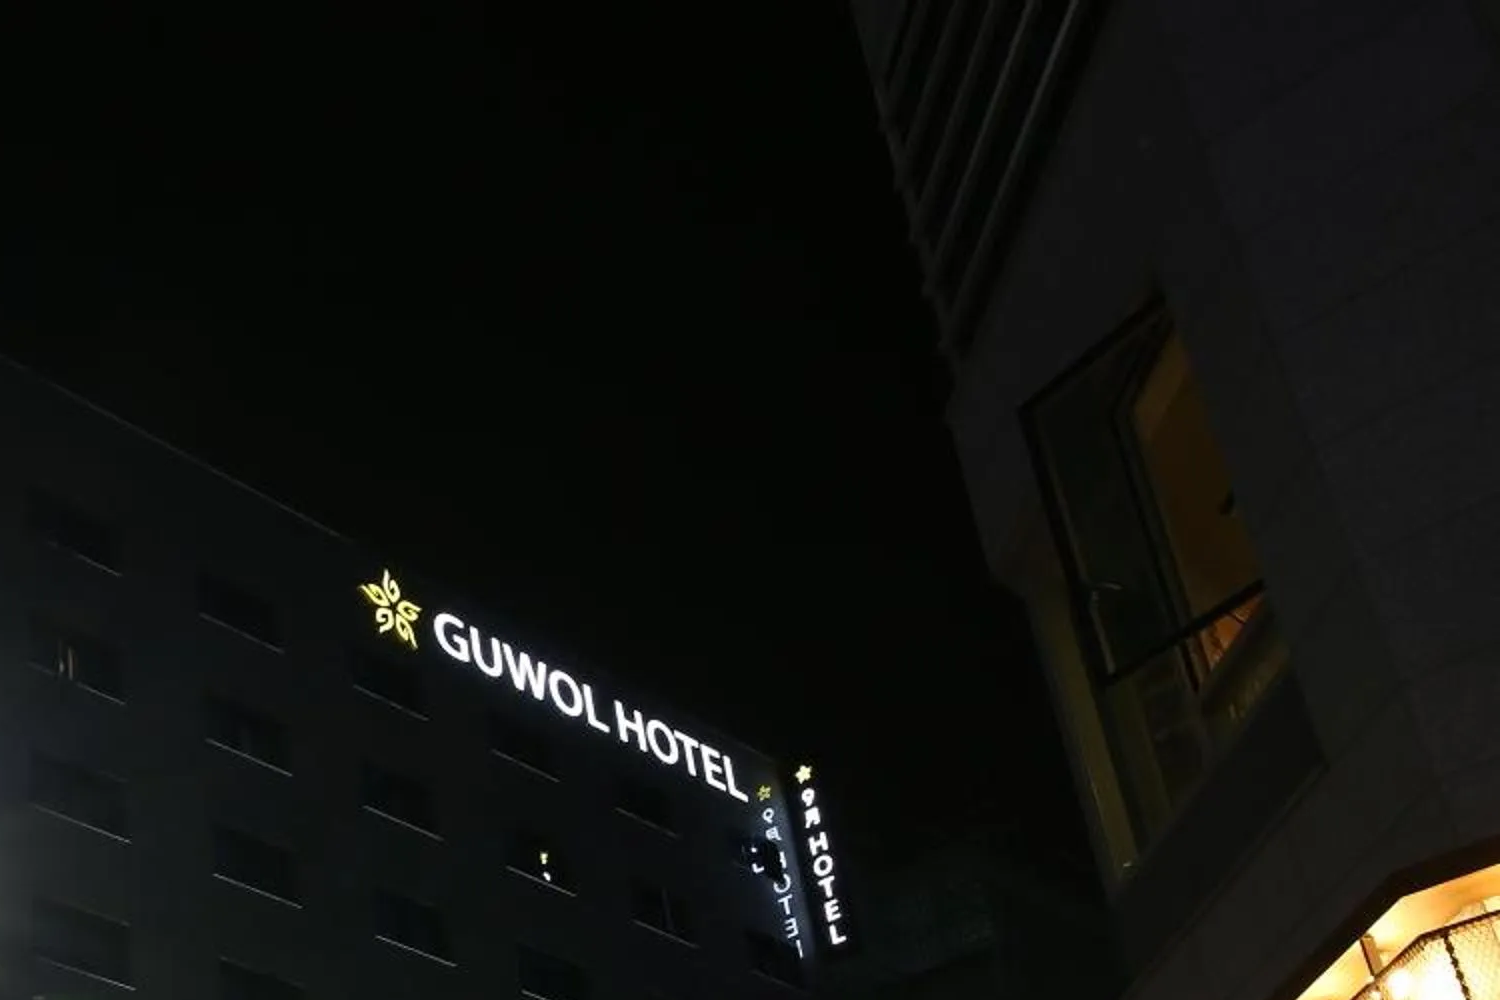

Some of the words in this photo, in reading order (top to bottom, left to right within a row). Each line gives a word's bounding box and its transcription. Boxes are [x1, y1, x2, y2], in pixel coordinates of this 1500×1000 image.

[433, 613, 610, 733] GUWOL
[614, 700, 749, 803] HOTEL
[808, 831, 847, 945] HOTEL
